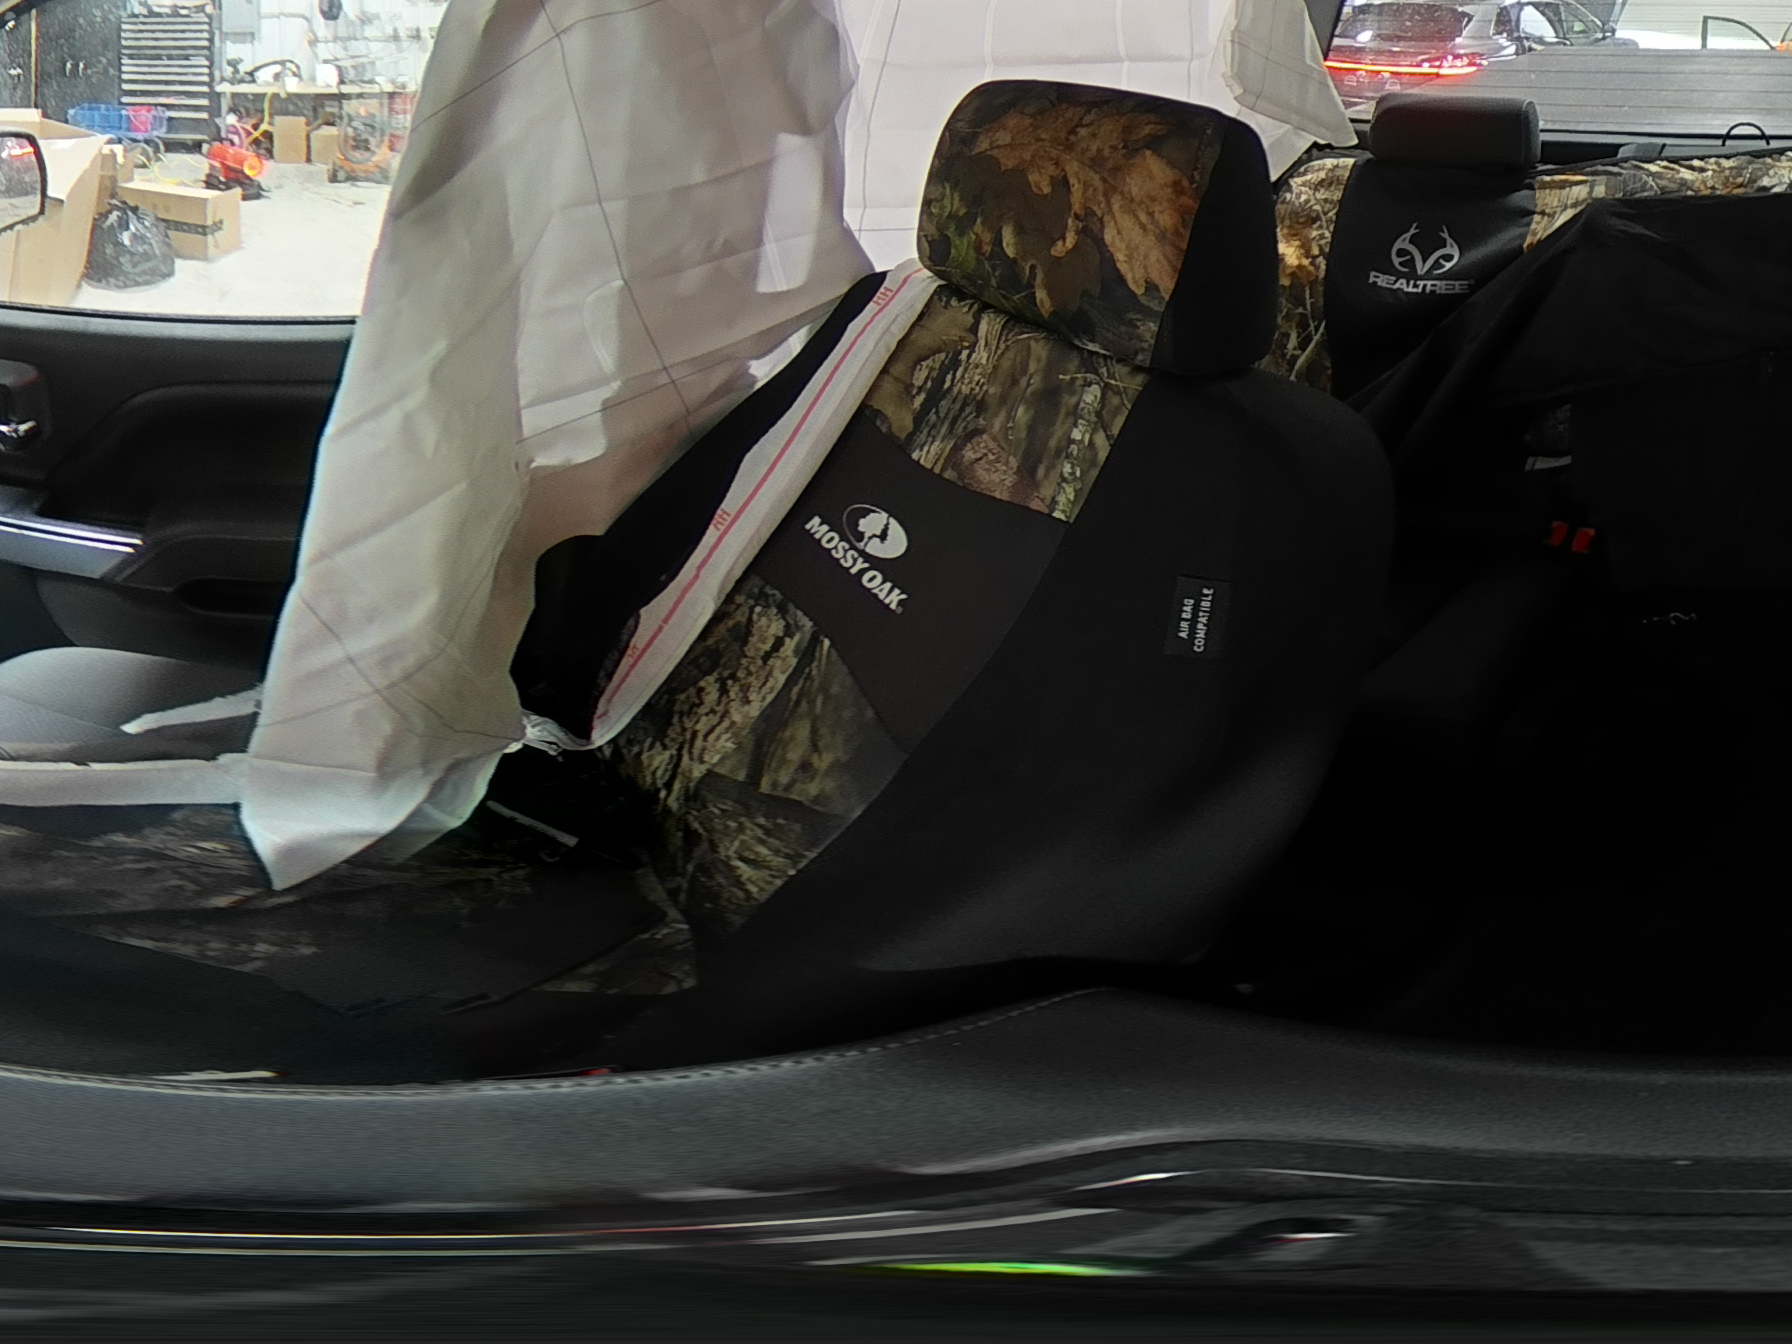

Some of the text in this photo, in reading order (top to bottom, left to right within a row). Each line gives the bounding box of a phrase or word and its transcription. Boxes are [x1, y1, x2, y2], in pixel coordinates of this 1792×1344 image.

[1368, 271, 1471, 294] REALTREE
[804, 516, 908, 611] MOSSY OAK
[1177, 620, 1192, 640] AIR
[1193, 587, 1215, 652] COMPATIBLE
